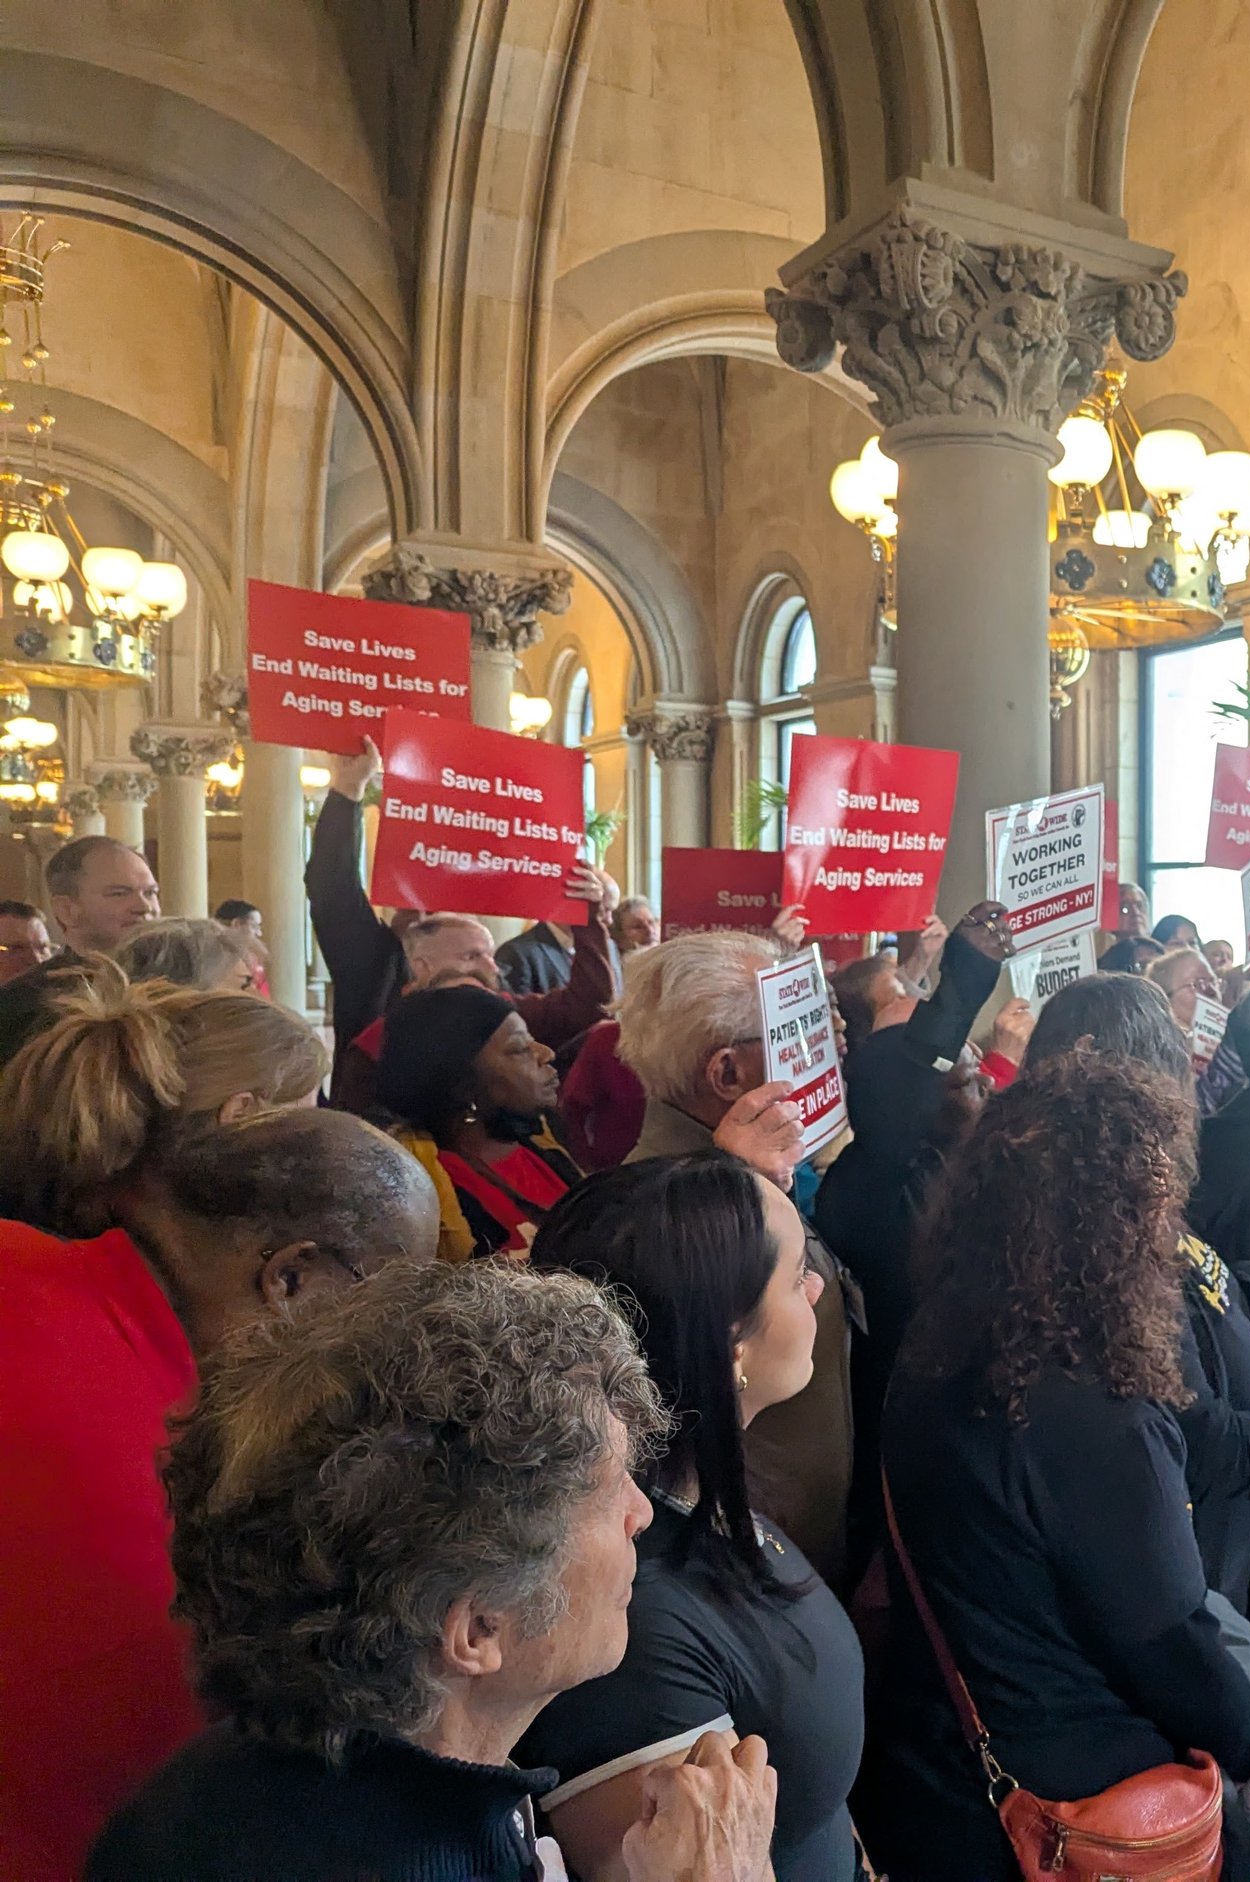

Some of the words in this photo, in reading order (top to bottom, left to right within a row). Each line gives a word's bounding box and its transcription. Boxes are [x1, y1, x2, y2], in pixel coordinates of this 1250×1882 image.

[304, 630, 355, 653] Save
[361, 639, 416, 661] Lives
[252, 655, 293, 676] End
[298, 660, 378, 691] Waiting
[383, 672, 434, 693] Lists
[439, 679, 468, 697] for
[282, 690, 343, 717] Aging
[441, 768, 490, 793] Save
[495, 778, 544, 803] Lives
[836, 788, 878, 811] Save
[881, 793, 920, 814] Lives
[384, 798, 427, 823] End
[433, 805, 509, 838] Waiting
[514, 819, 558, 842] Lists
[561, 826, 584, 846] for
[1212, 799, 1237, 816] End
[790, 825, 825, 846] End
[830, 827, 890, 854] Waiting
[893, 832, 927, 851] Lists
[928, 834, 947, 851] for
[1012, 833, 1082, 867] WORKING
[410, 842, 472, 870] Aging
[478, 850, 563, 878] Services
[1008, 853, 1085, 889] TOGETHER
[814, 867, 862, 891] Aging
[864, 868, 924, 888] Services
[1018, 891, 1029, 902] SO
[1031, 885, 1043, 897] WE
[1046, 880, 1062, 893] CAN
[1064, 874, 1079, 886] ALL
[717, 890, 767, 907] Save
[1009, 915, 1023, 930] GE
[1024, 898, 1068, 925] STRONG
[1075, 889, 1094, 907] NY!
[1055, 953, 1081, 965] Demand
[1035, 965, 1080, 998] BUDGET
[806, 1092, 818, 1116] IN
[816, 1076, 840, 1108] PLACE
